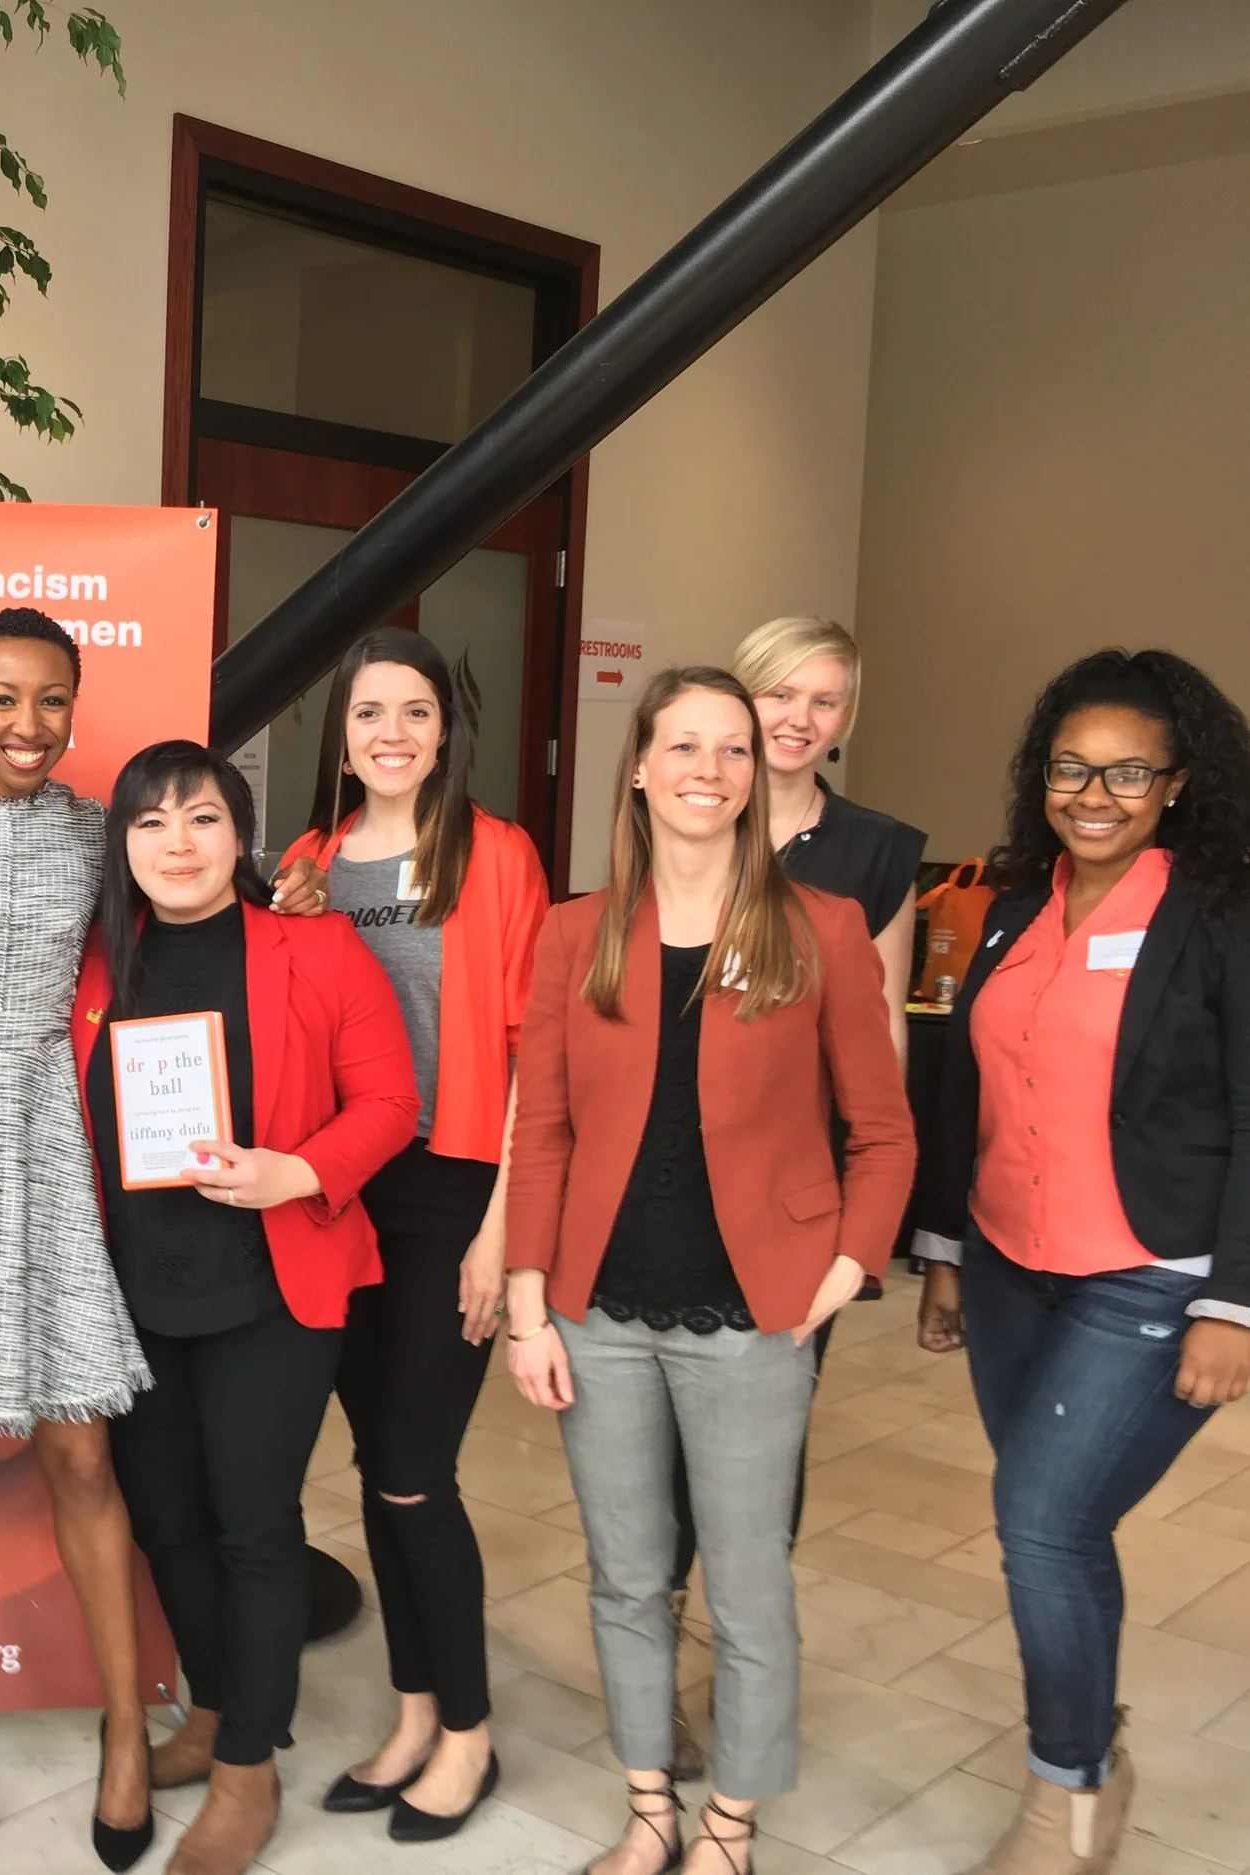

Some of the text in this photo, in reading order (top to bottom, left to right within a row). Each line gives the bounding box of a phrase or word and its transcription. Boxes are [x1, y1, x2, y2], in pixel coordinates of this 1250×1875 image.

[56, 618, 142, 647] men
[578, 640, 643, 660] RESTROOMS
[174, 1051, 203, 1069] the
[149, 1078, 183, 1096] ball
[130, 1122, 211, 1141] tiffany dufu
